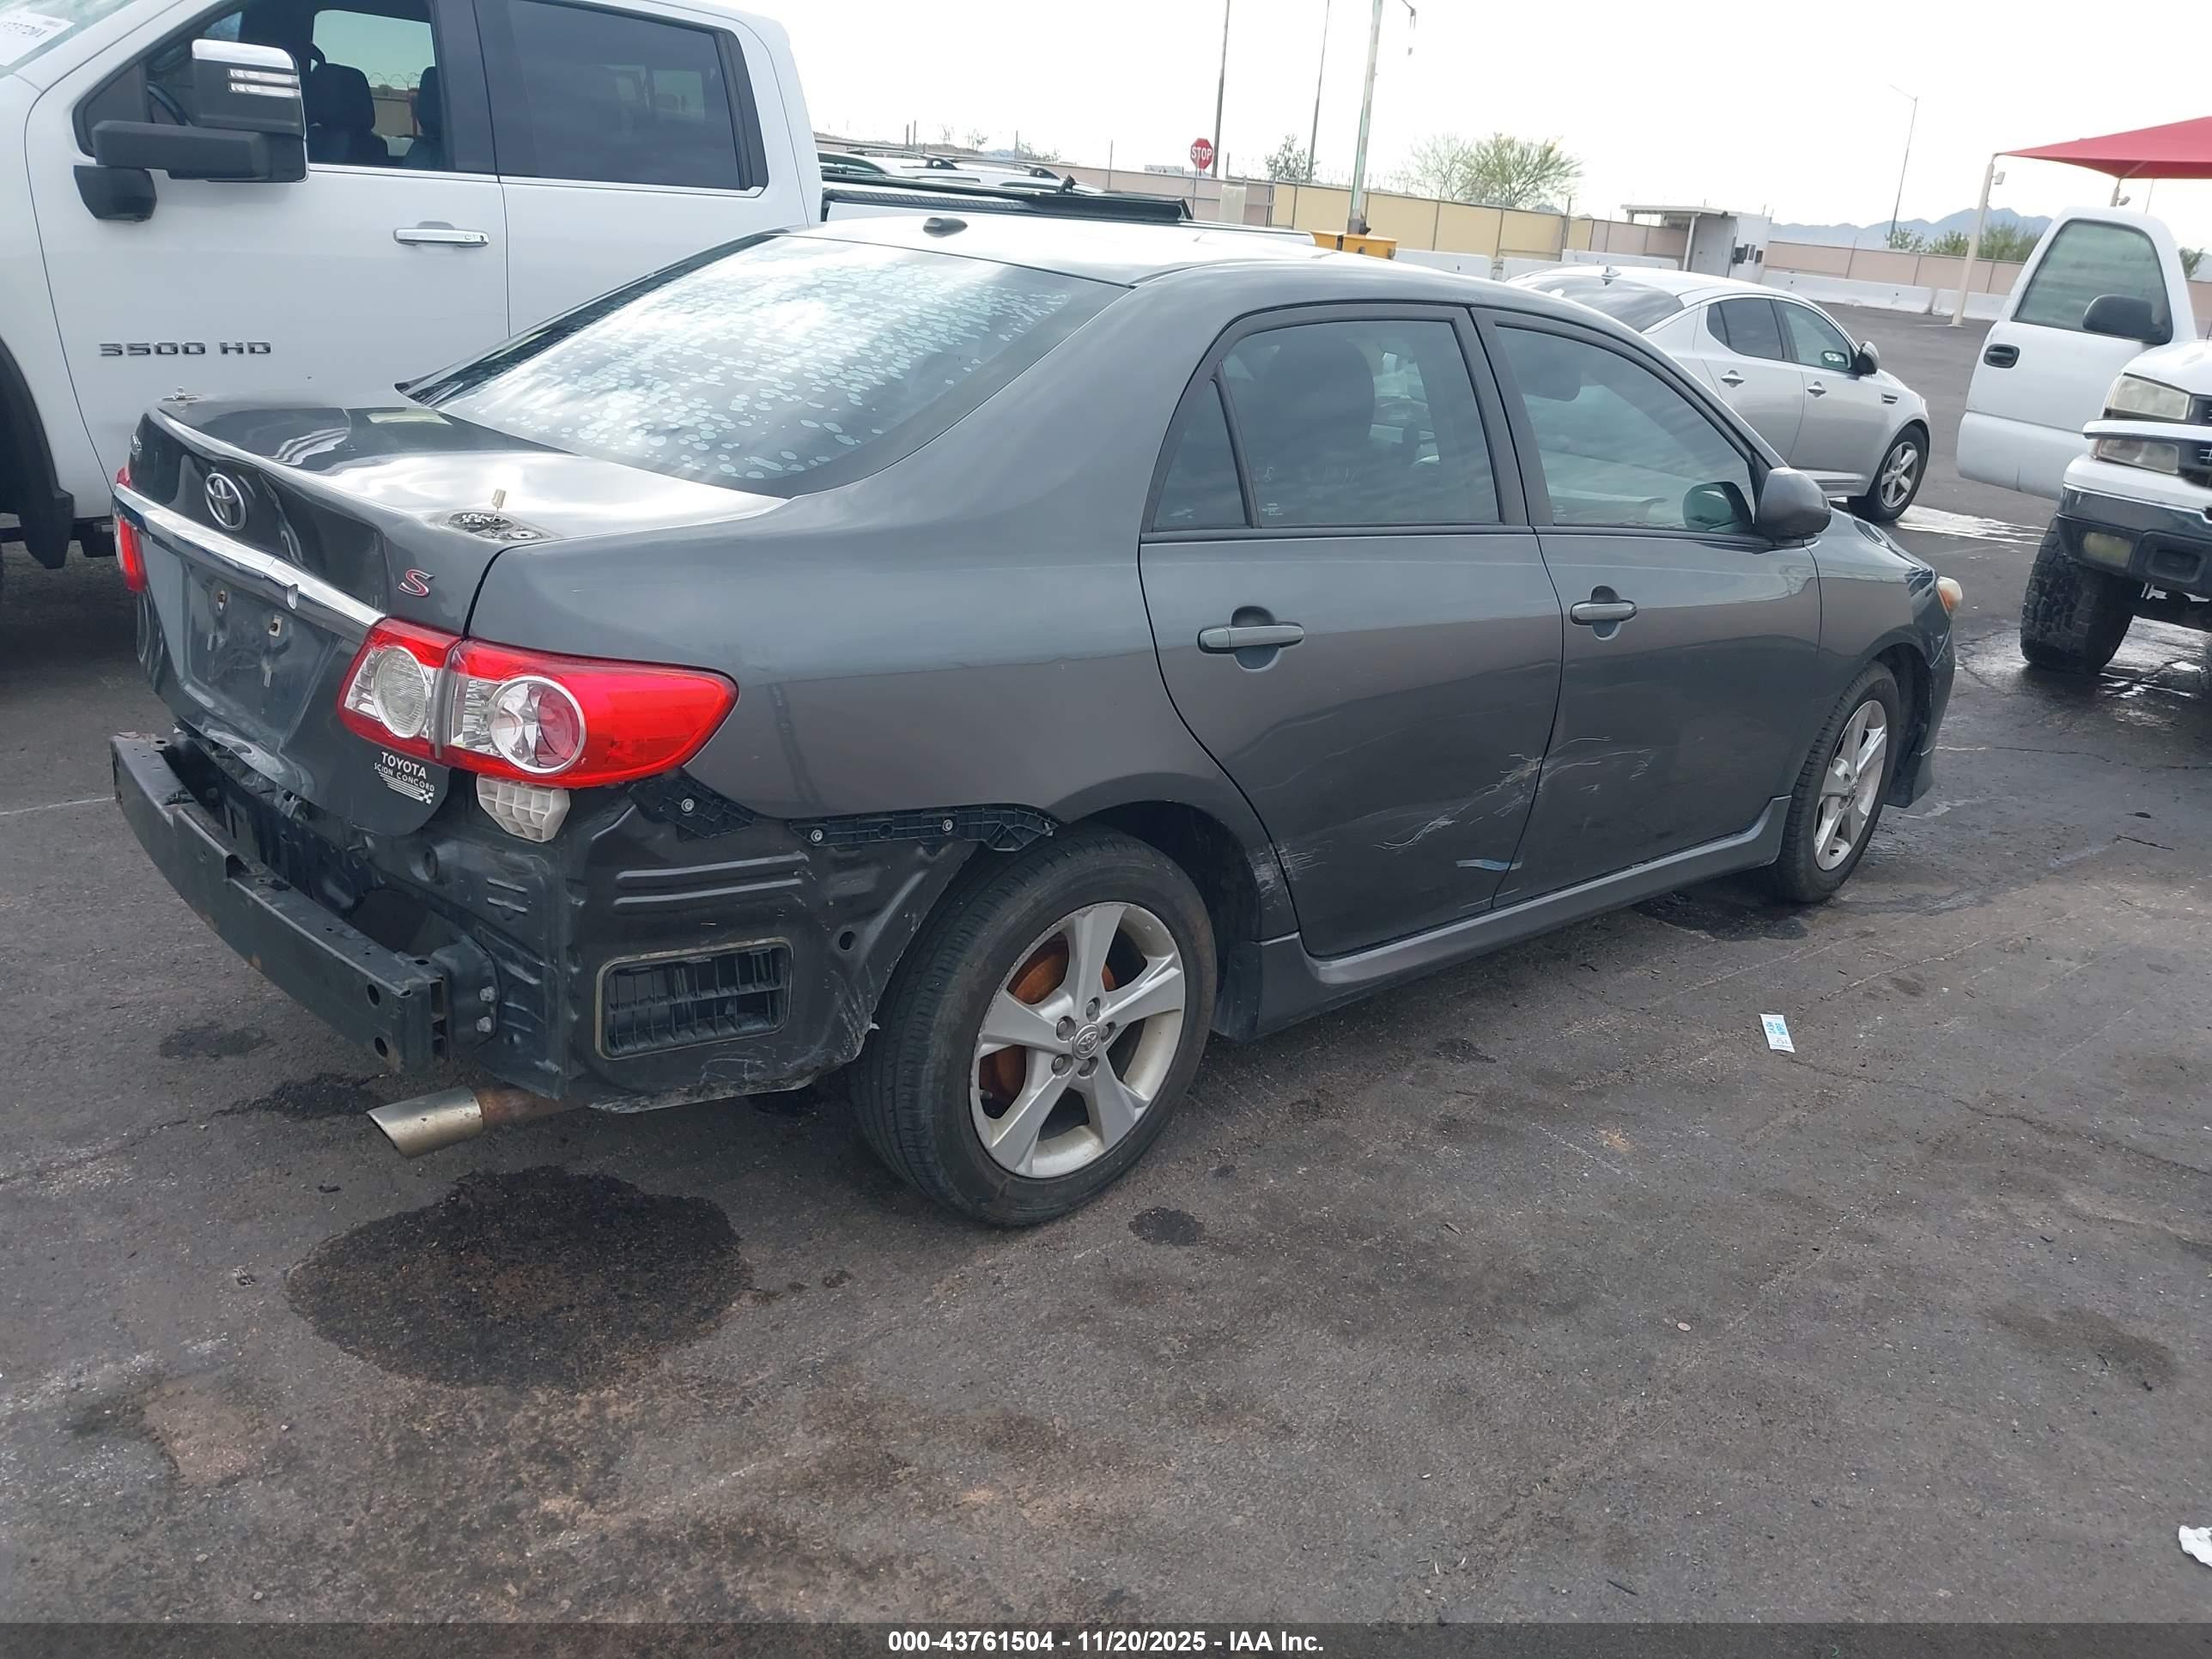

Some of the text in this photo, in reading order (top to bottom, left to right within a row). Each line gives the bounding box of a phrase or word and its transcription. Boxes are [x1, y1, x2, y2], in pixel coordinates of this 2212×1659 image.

[1191, 146, 1212, 161] STOP
[99, 341, 271, 357] 3500 HD
[398, 568, 434, 597] S
[374, 762, 435, 793] SCION CONCORD
[380, 750, 427, 780] TOYOTA
